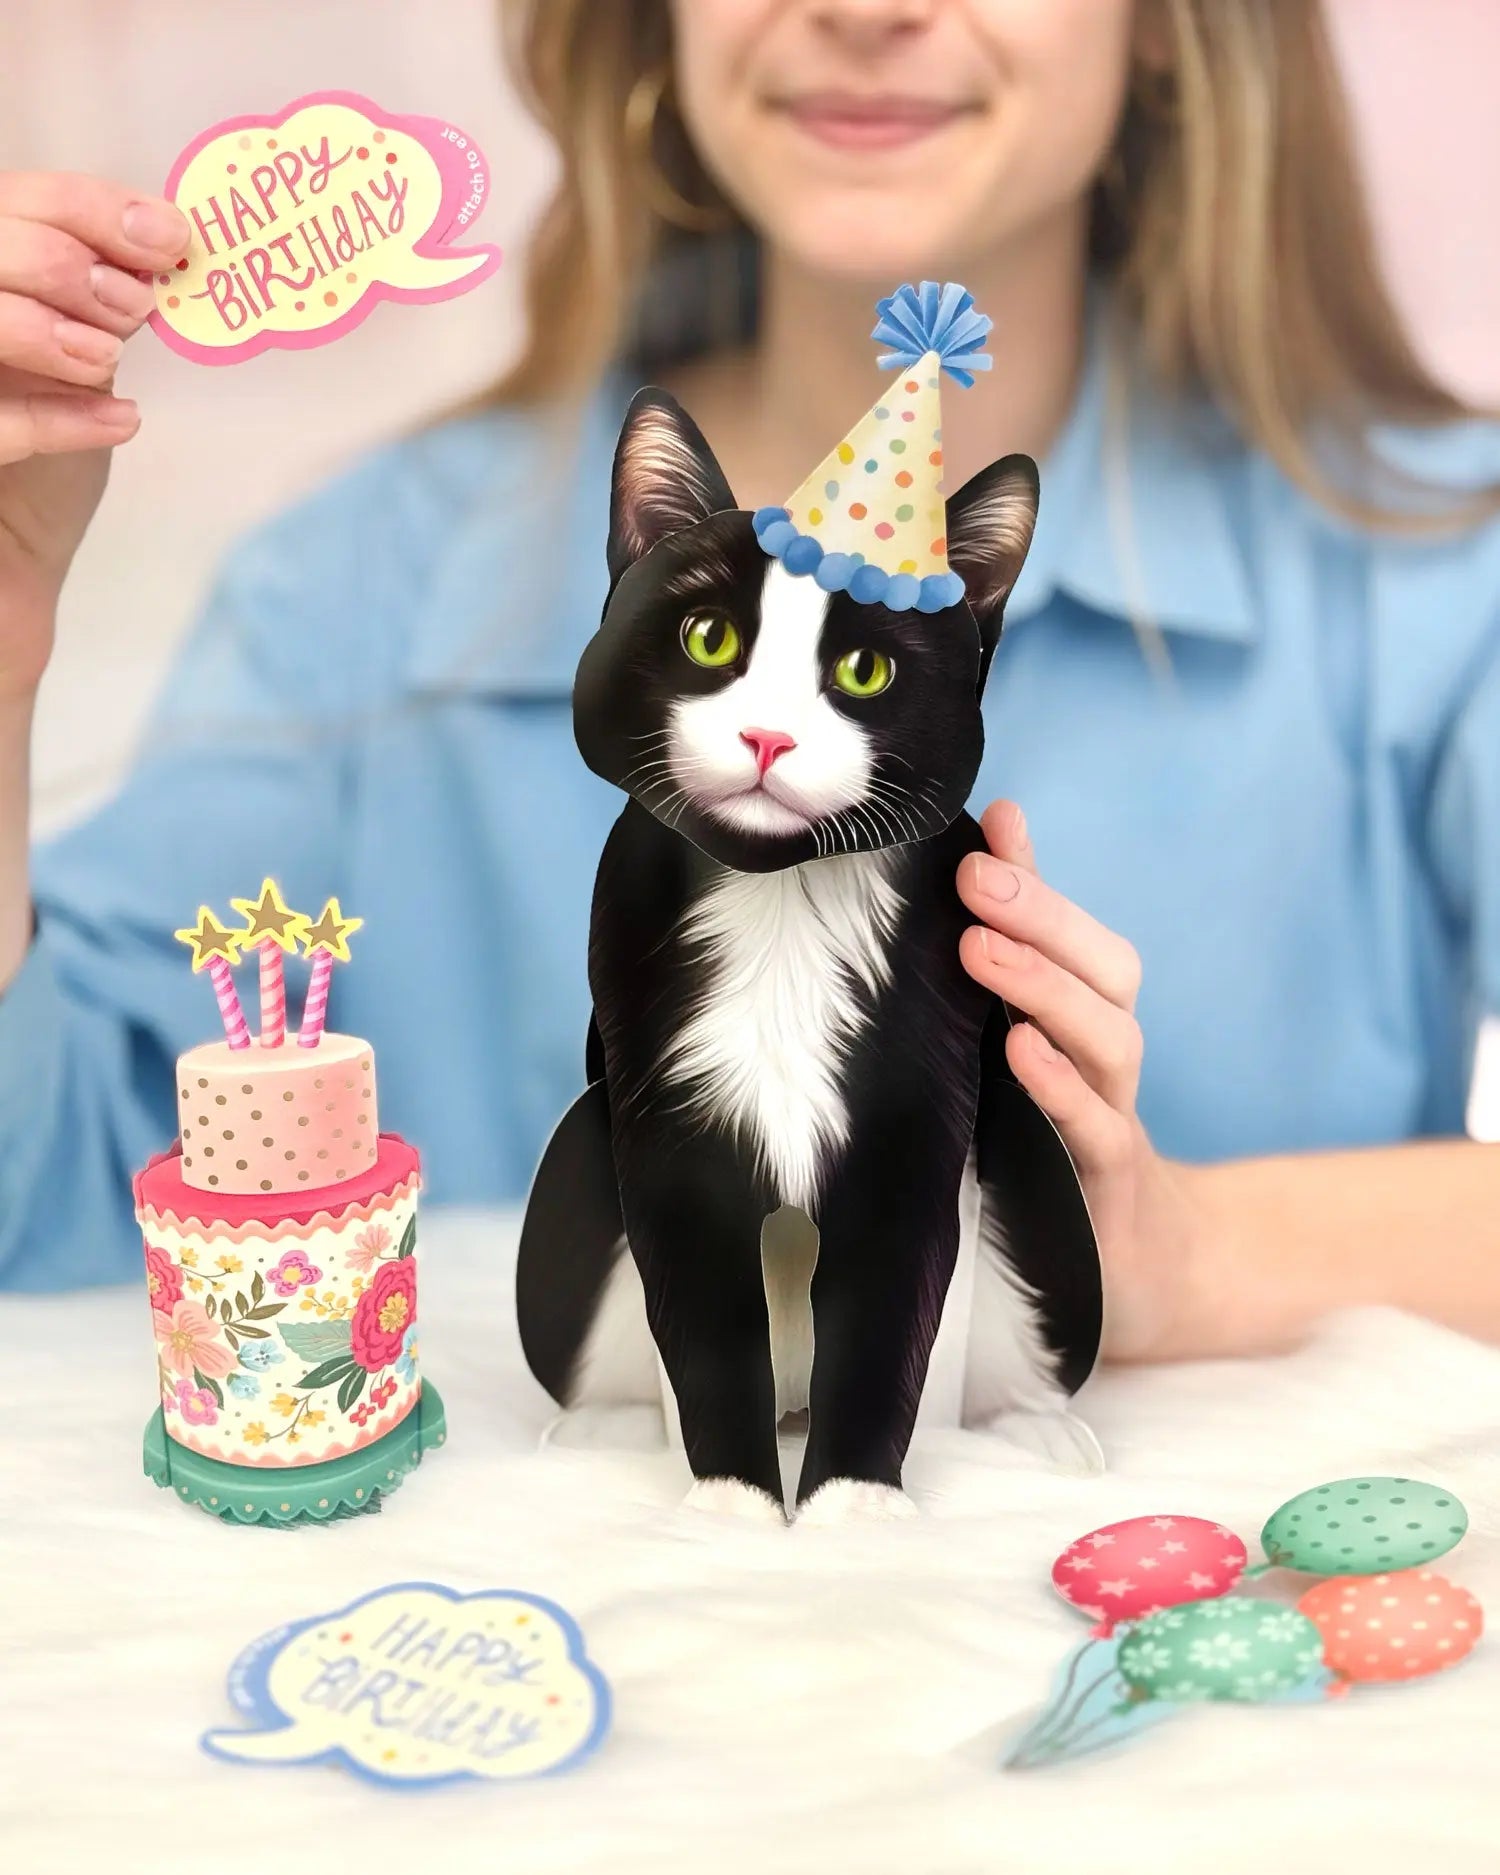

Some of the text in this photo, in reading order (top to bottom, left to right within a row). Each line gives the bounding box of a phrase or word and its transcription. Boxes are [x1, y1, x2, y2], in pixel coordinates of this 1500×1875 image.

[190, 136, 353, 256] HAPPY
[440, 127, 485, 225] attach to ear
